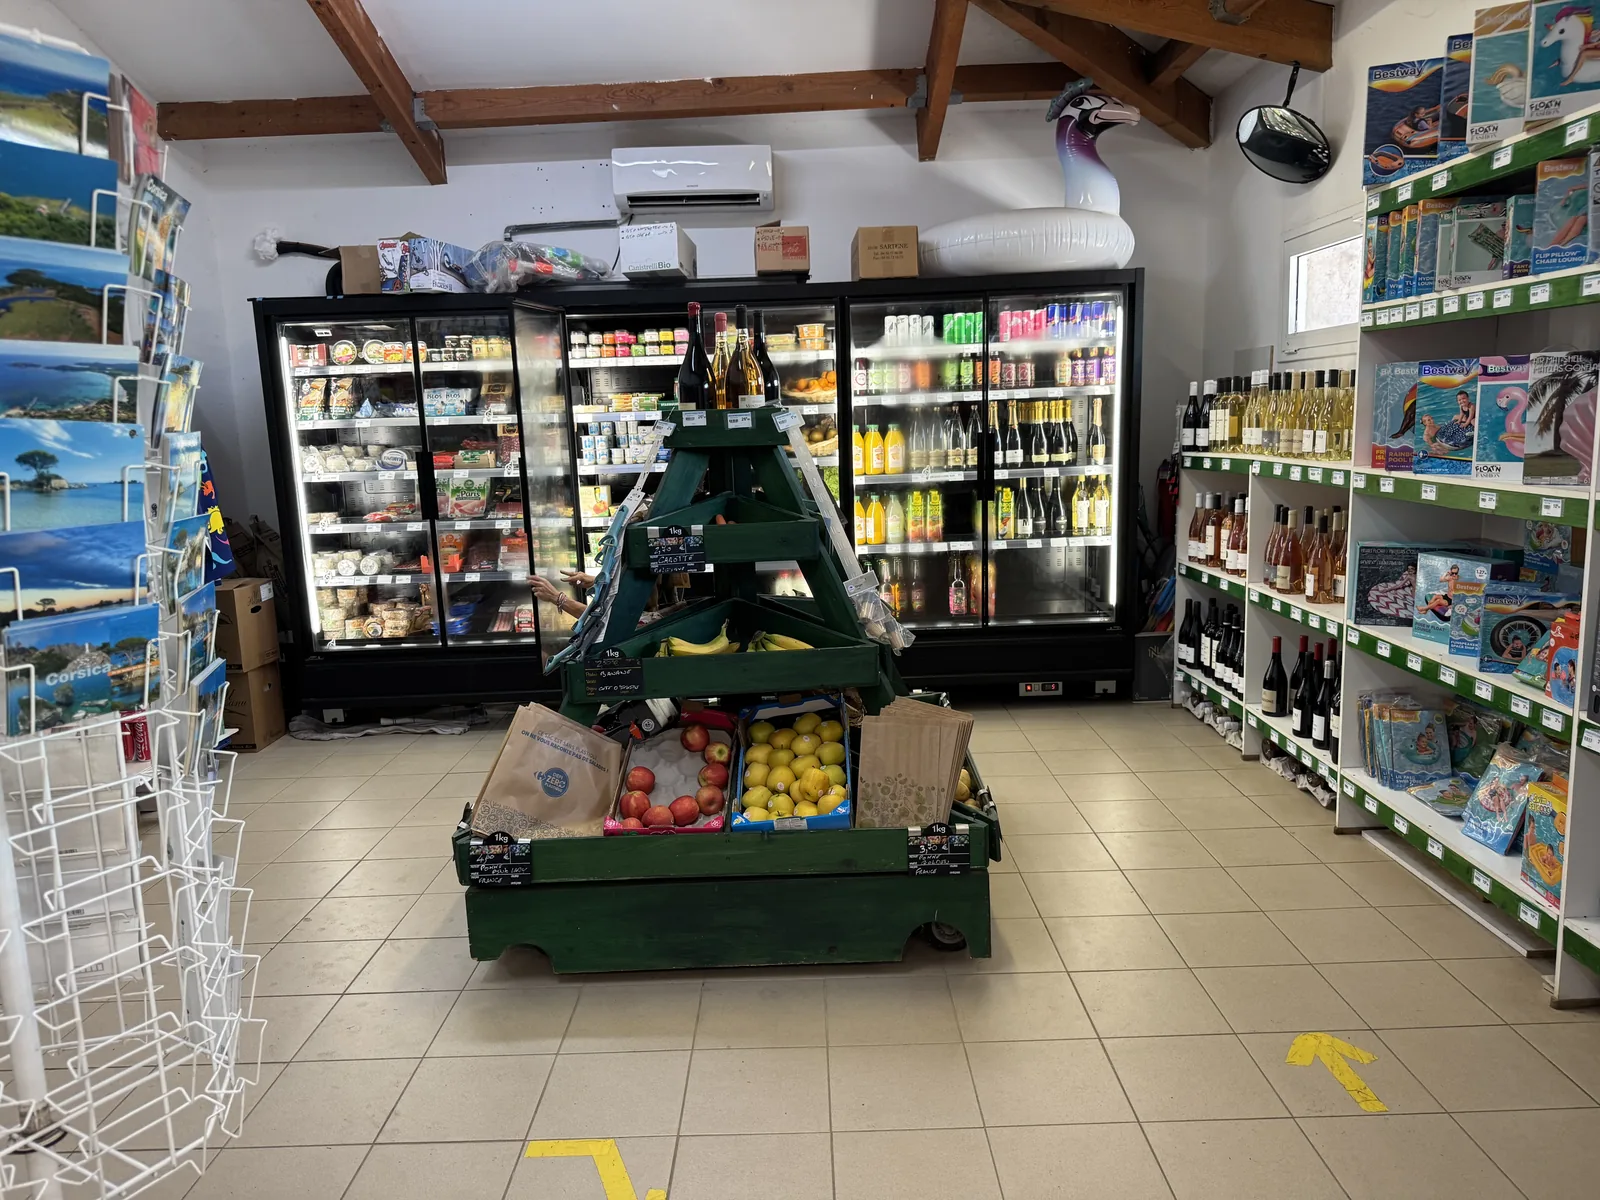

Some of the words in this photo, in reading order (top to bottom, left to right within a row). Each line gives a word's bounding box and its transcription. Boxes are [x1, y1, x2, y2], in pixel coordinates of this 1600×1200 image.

[1373, 66, 1424, 81] Bestway
[1543, 163, 1579, 173] Bestway
[1422, 365, 1473, 377] Bestway
[1488, 364, 1529, 373] Bestway
[669, 526, 682, 535] 1kg
[1487, 597, 1523, 607] Bestway
[606, 649, 619, 658] 1kg
[45, 662, 112, 687] Corsica
[536, 735, 551, 746] VOUS
[571, 751, 582, 760] PAS
[546, 775, 566, 788] ZERO
[931, 824, 946, 833] 1kg
[495, 833, 509, 843] 1kg
